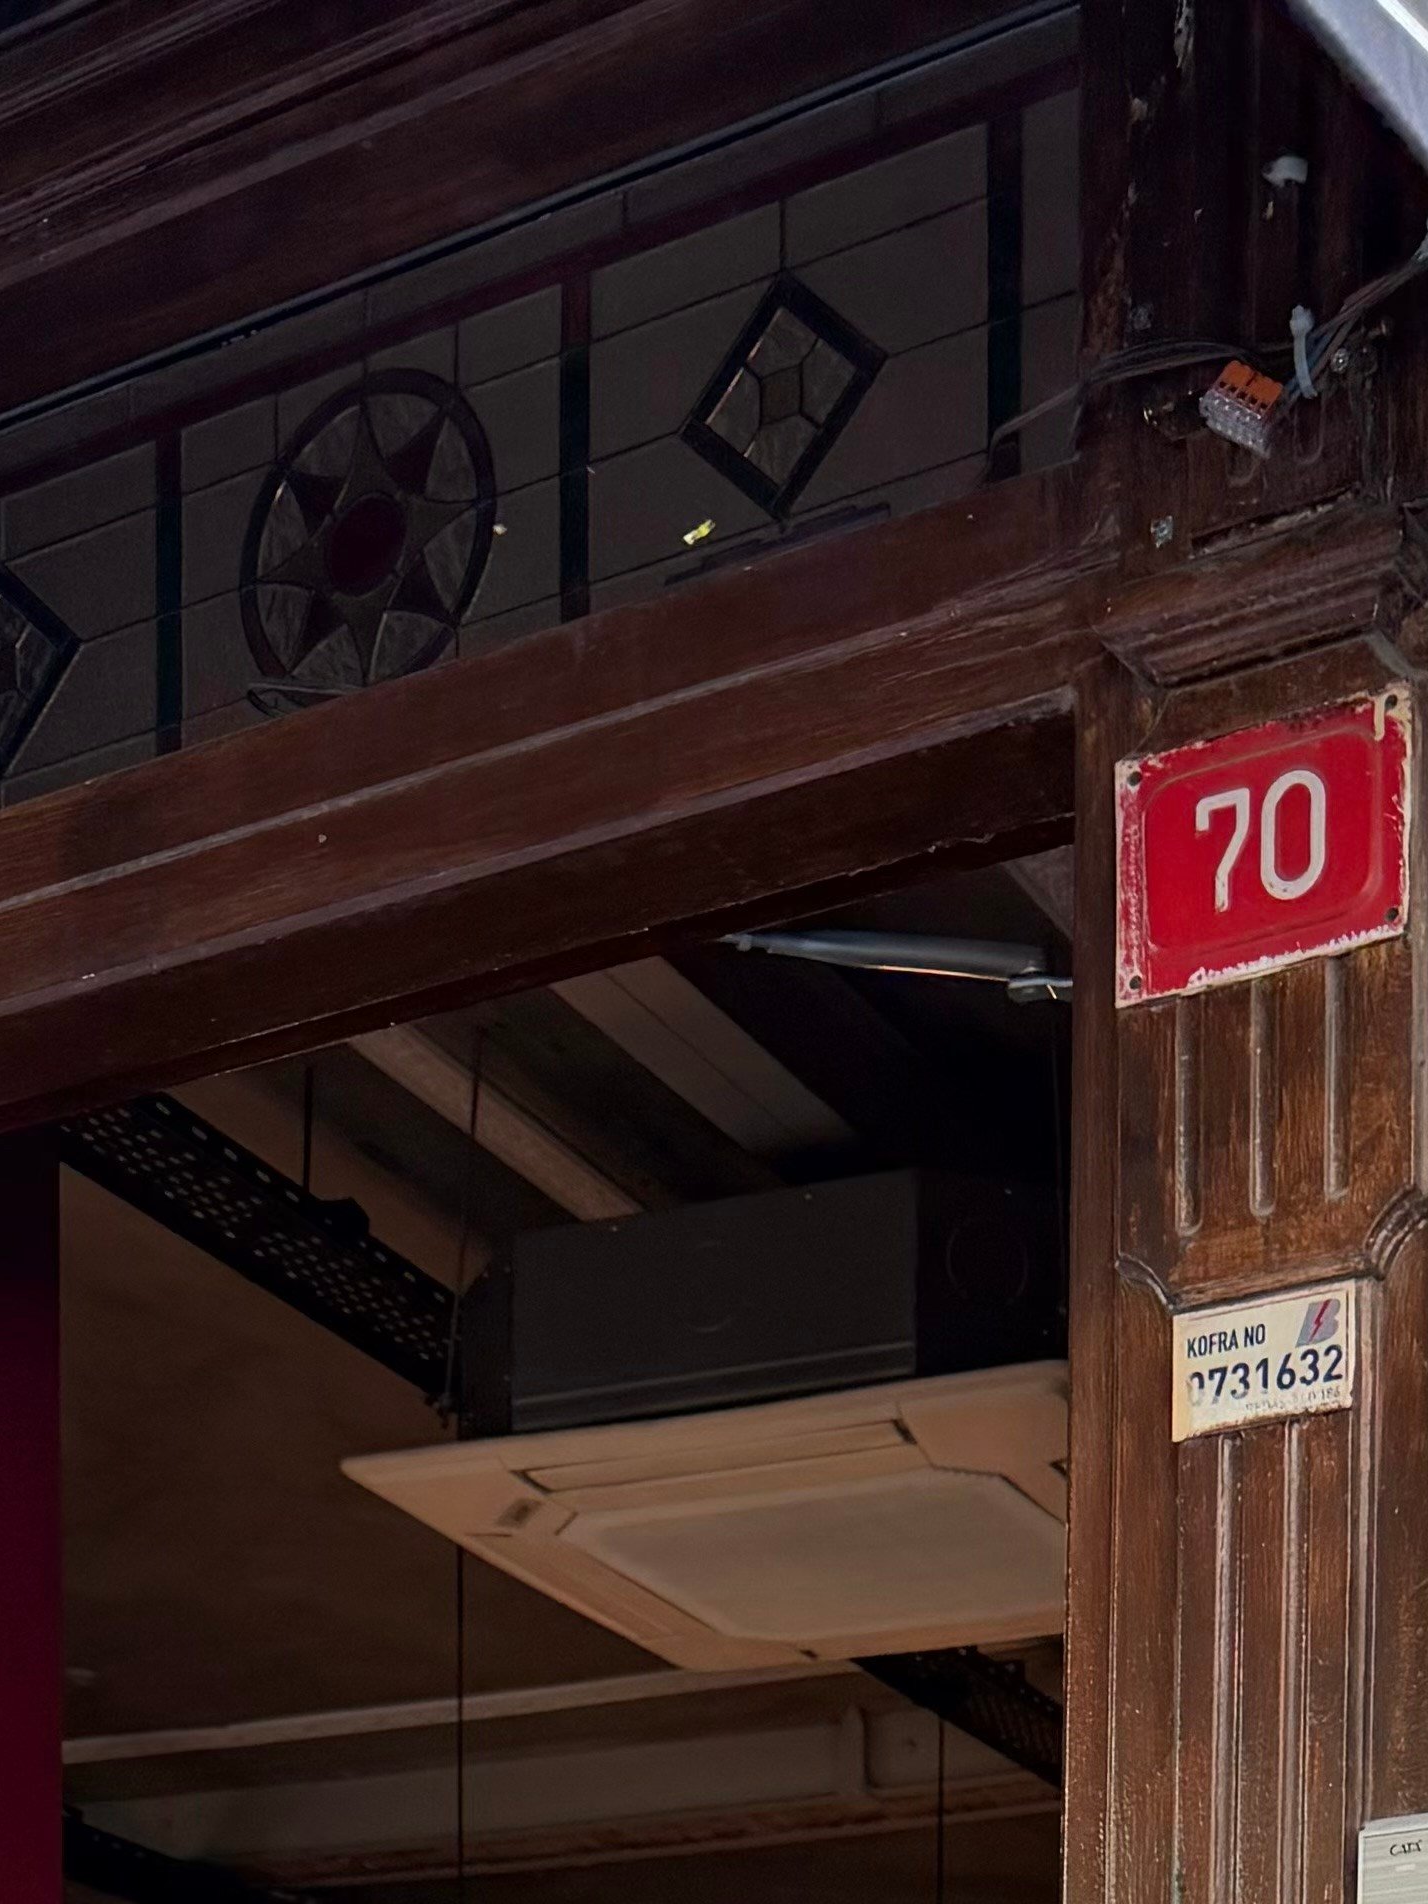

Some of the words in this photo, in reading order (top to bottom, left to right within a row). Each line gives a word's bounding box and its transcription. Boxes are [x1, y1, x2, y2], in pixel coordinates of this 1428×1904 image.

[1194, 768, 1326, 913] 70
[1186, 1329, 1239, 1359] KOFRA
[1243, 1323, 1267, 1347] NO
